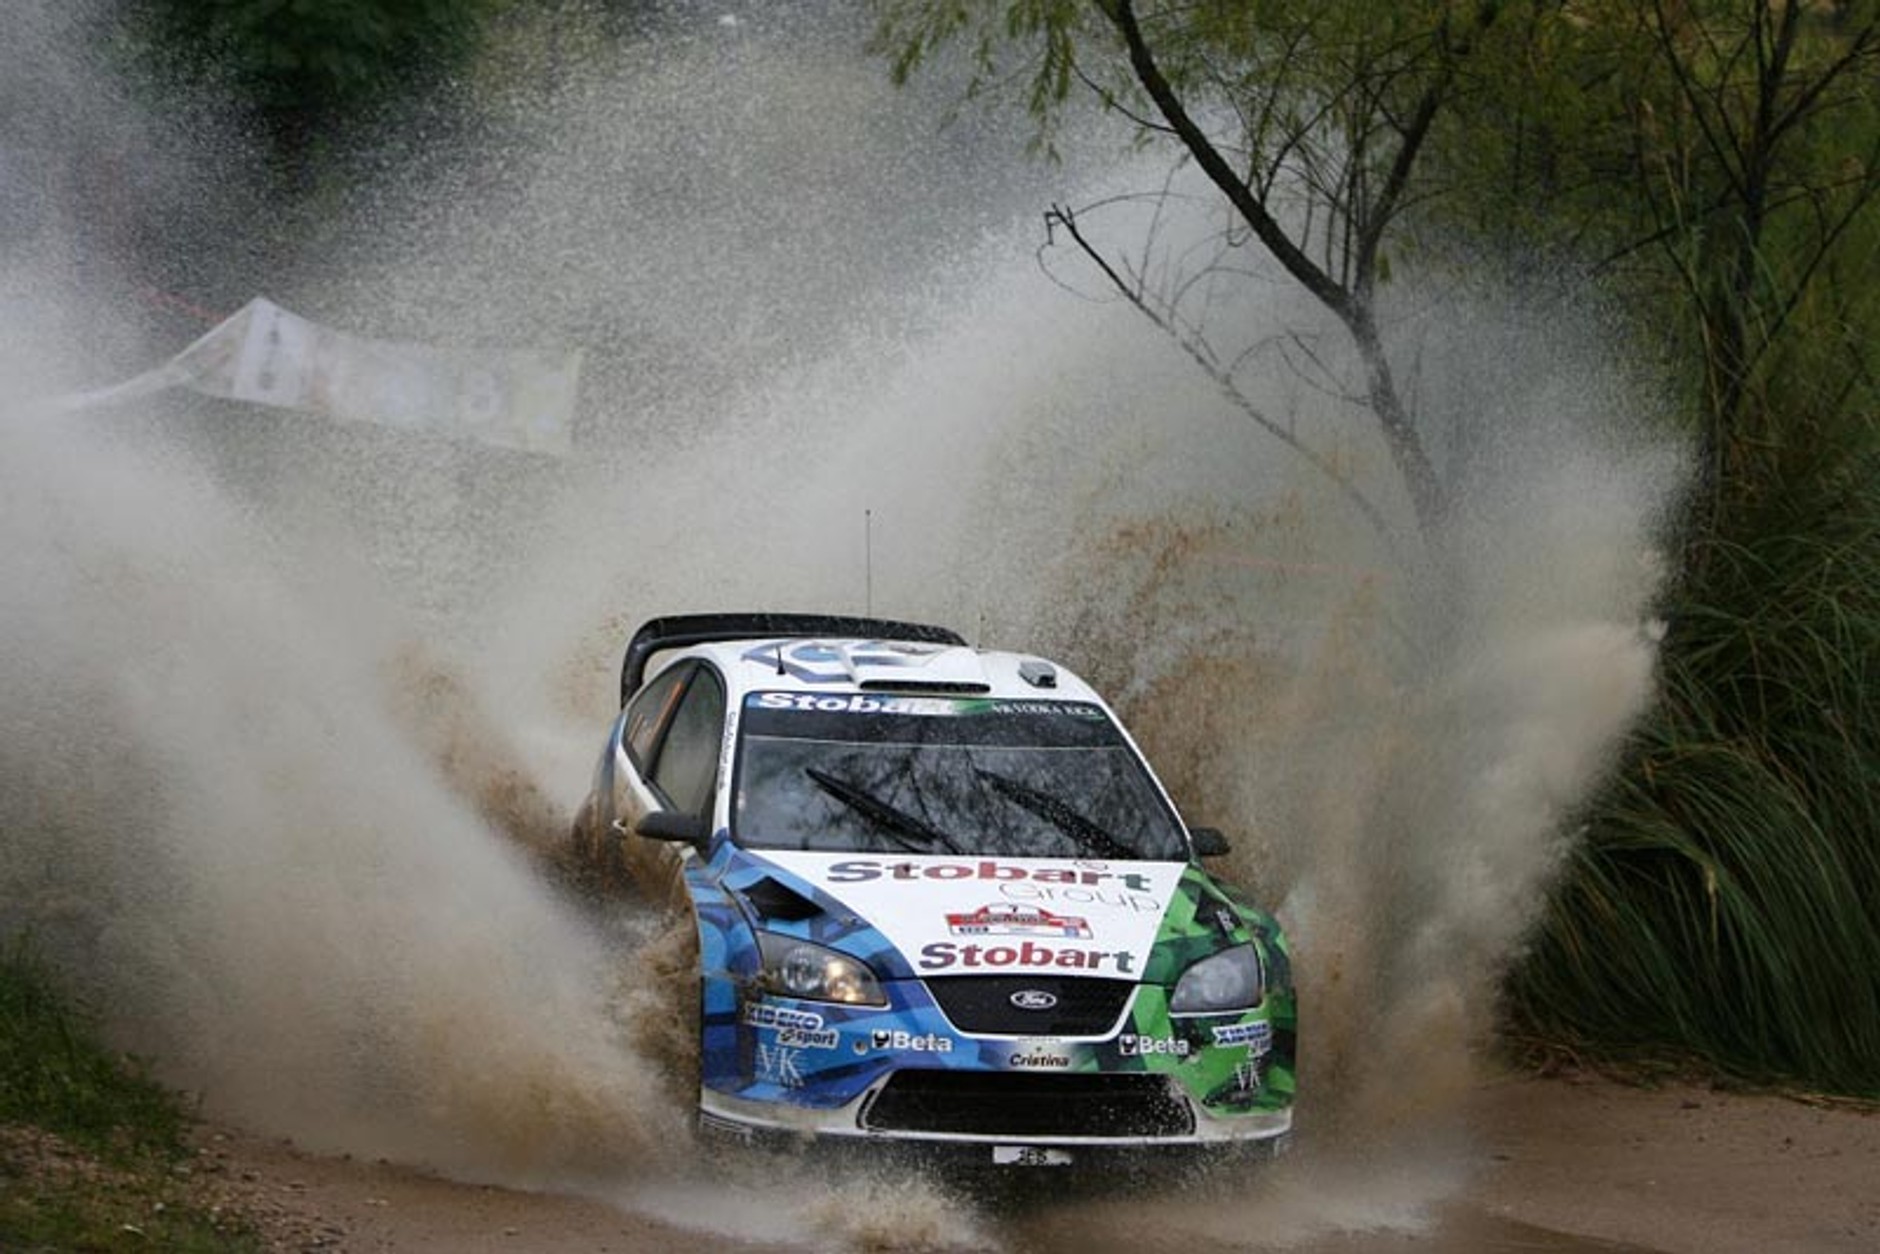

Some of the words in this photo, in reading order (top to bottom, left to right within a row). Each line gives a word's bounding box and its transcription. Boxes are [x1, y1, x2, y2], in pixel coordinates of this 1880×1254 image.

[827, 861, 1152, 892] Stobart
[999, 882, 1161, 912] Group
[918, 941, 1138, 974] Stobart
[894, 1031, 953, 1052] Beta
[1139, 1035, 1189, 1054] Beta
[1009, 1053, 1069, 1068] Cristina
